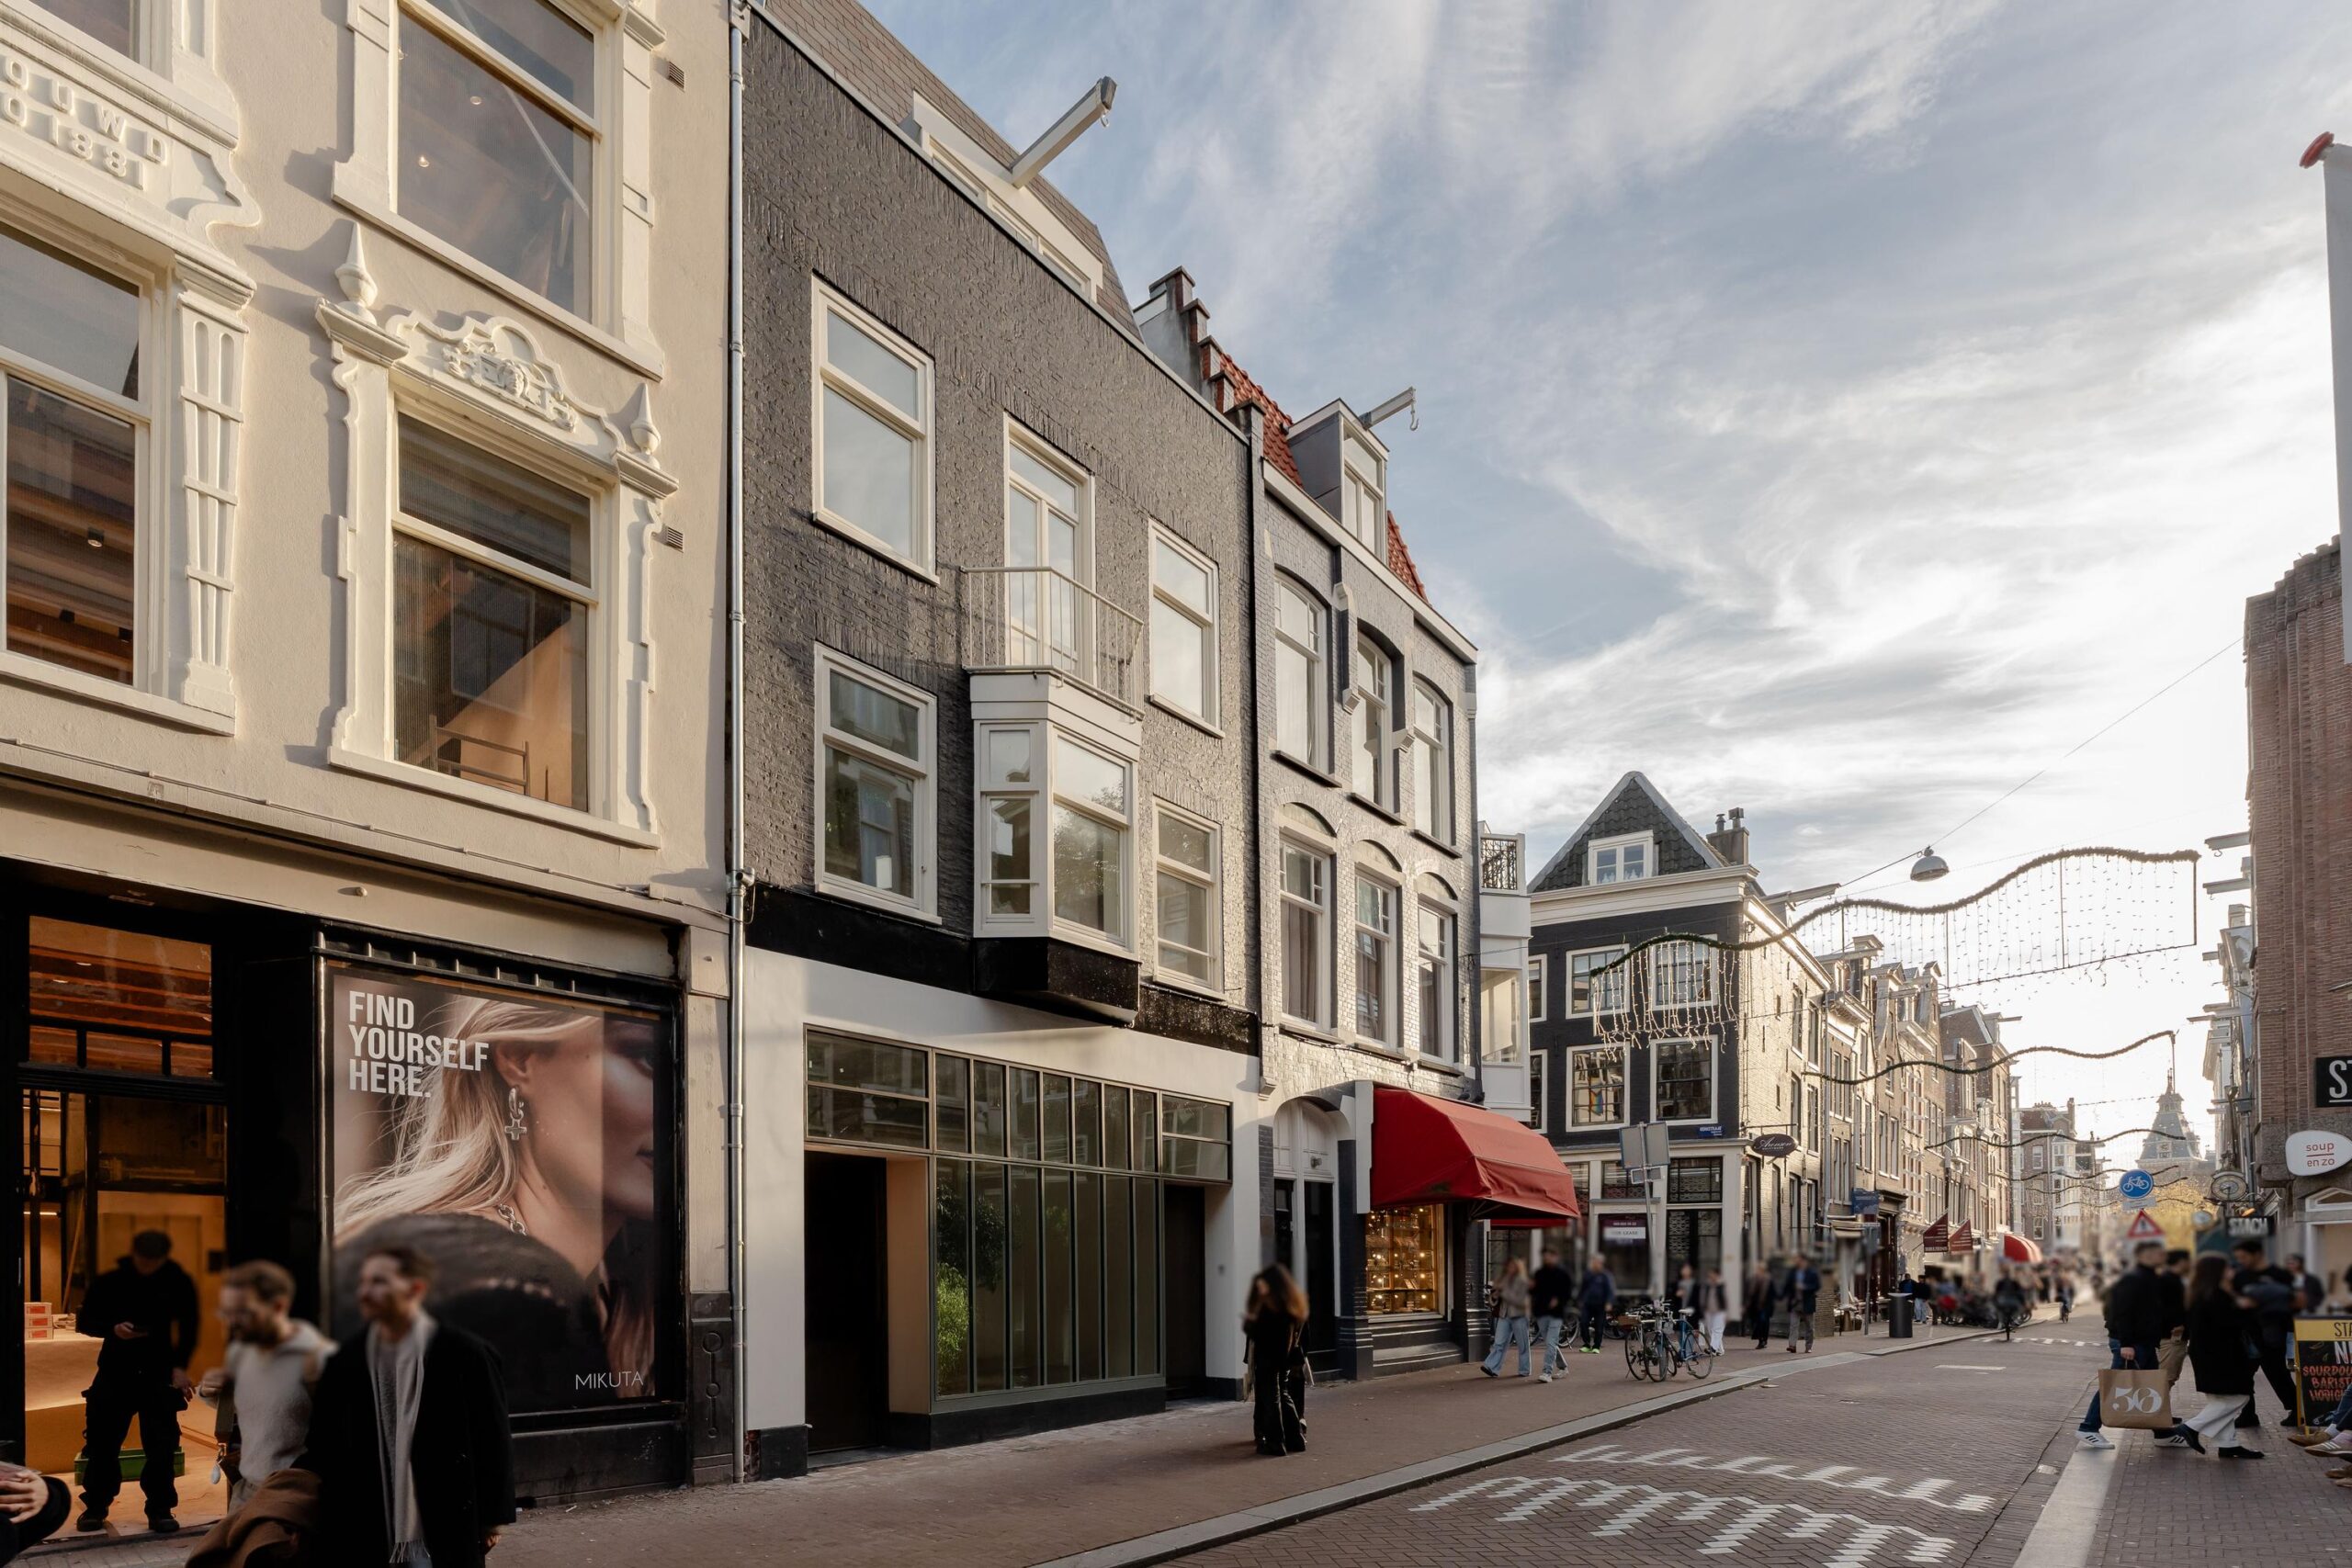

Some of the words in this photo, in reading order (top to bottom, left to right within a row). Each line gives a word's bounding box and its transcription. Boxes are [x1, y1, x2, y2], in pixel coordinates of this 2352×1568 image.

[349, 990, 414, 1031] FIND
[348, 1024, 490, 1072] YOURSELF
[349, 1058, 432, 1098] HERE.
[2328, 1059, 2352, 1099] S
[2305, 1142, 2335, 1153] soup
[2306, 1158, 2320, 1168] en
[2321, 1157, 2335, 1167] zo
[575, 1371, 644, 1391] MIKUTA
